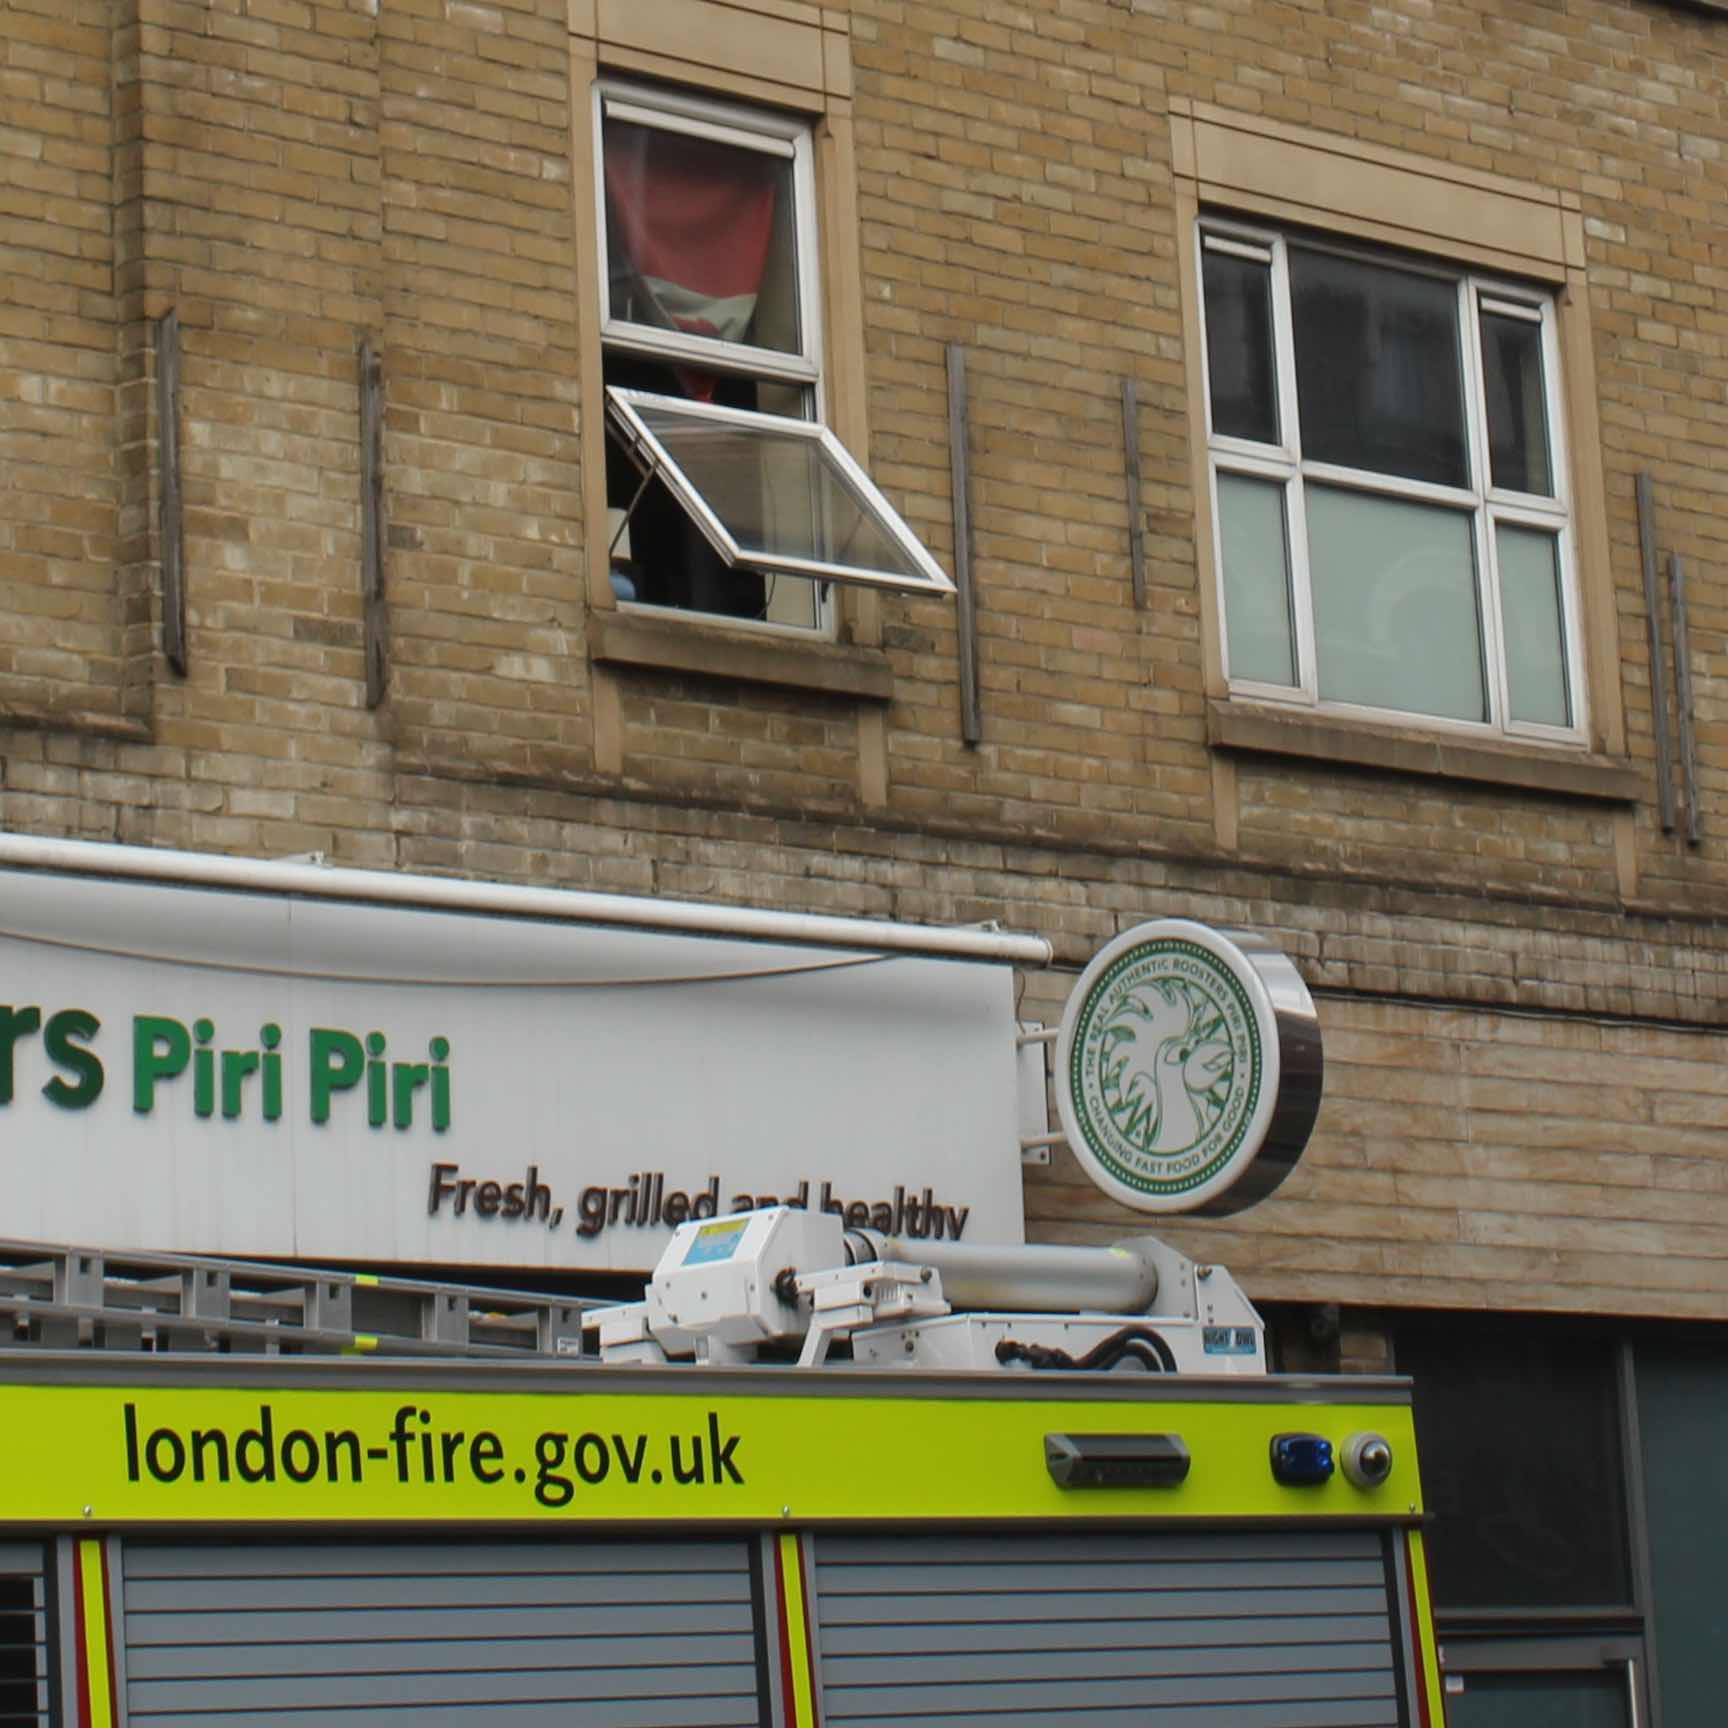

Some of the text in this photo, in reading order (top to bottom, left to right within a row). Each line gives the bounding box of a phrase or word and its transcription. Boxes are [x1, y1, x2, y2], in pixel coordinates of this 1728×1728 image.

[1109, 959, 1169, 1004] AUTHENTIC
[1172, 958, 1228, 1000] ROOSTERS
[1090, 1004, 1112, 1041] REAL
[131, 1015, 284, 1124] Piri
[308, 1026, 452, 1134] Piri
[1085, 1048, 1096, 1075] THE
[1088, 1086, 1245, 1173] CHANGING FAST FOOD FOR GOOD
[426, 1162, 563, 1230] Fresh,
[575, 1172, 721, 1238] grilled
[123, 1402, 746, 1508] london-fire.gov.uk
